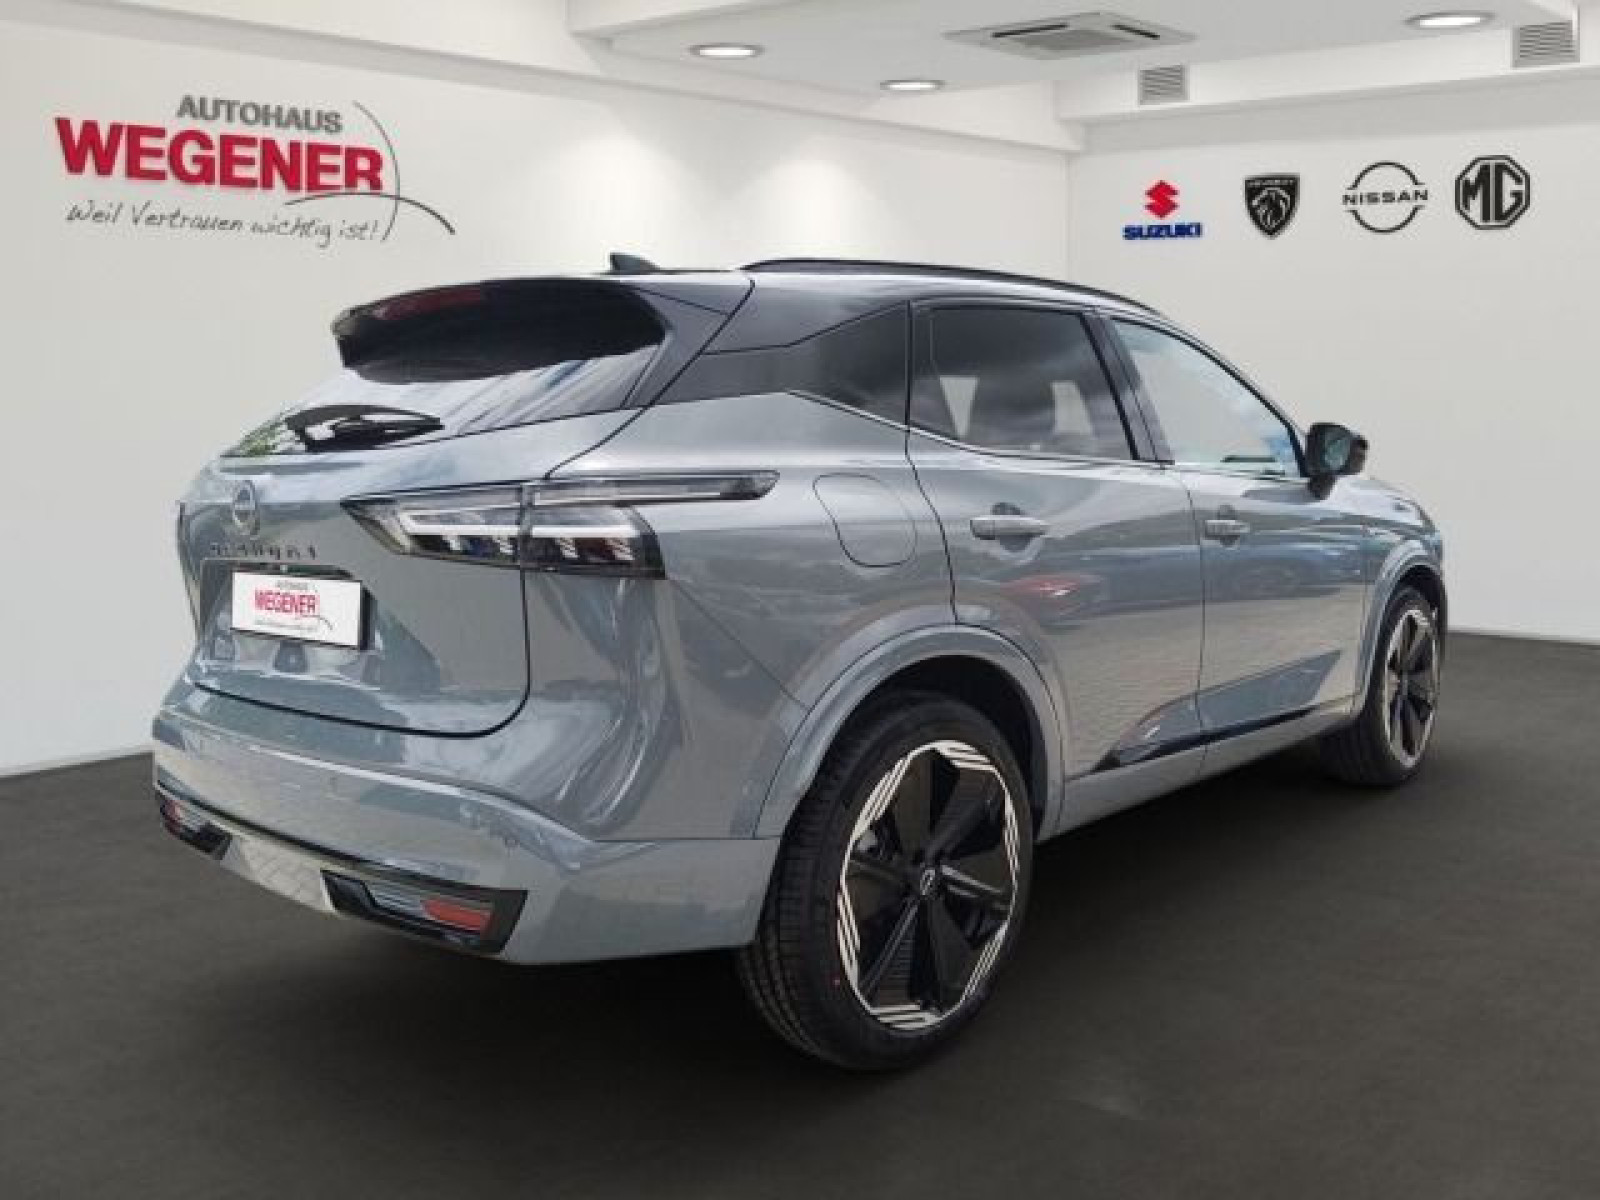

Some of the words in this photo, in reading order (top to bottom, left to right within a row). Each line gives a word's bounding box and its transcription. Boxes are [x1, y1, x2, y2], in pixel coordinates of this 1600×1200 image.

[176, 94, 343, 133] AUTOHAUS
[55, 117, 384, 193] WEGENER
[1342, 187, 1428, 206] NISSAN
[1464, 161, 1524, 224] MG
[65, 199, 123, 224] Weil
[132, 200, 243, 231] Vertrauen
[249, 214, 333, 248] wichtig
[1122, 222, 1203, 240] SUZUKI
[254, 590, 316, 614] WEGENER
